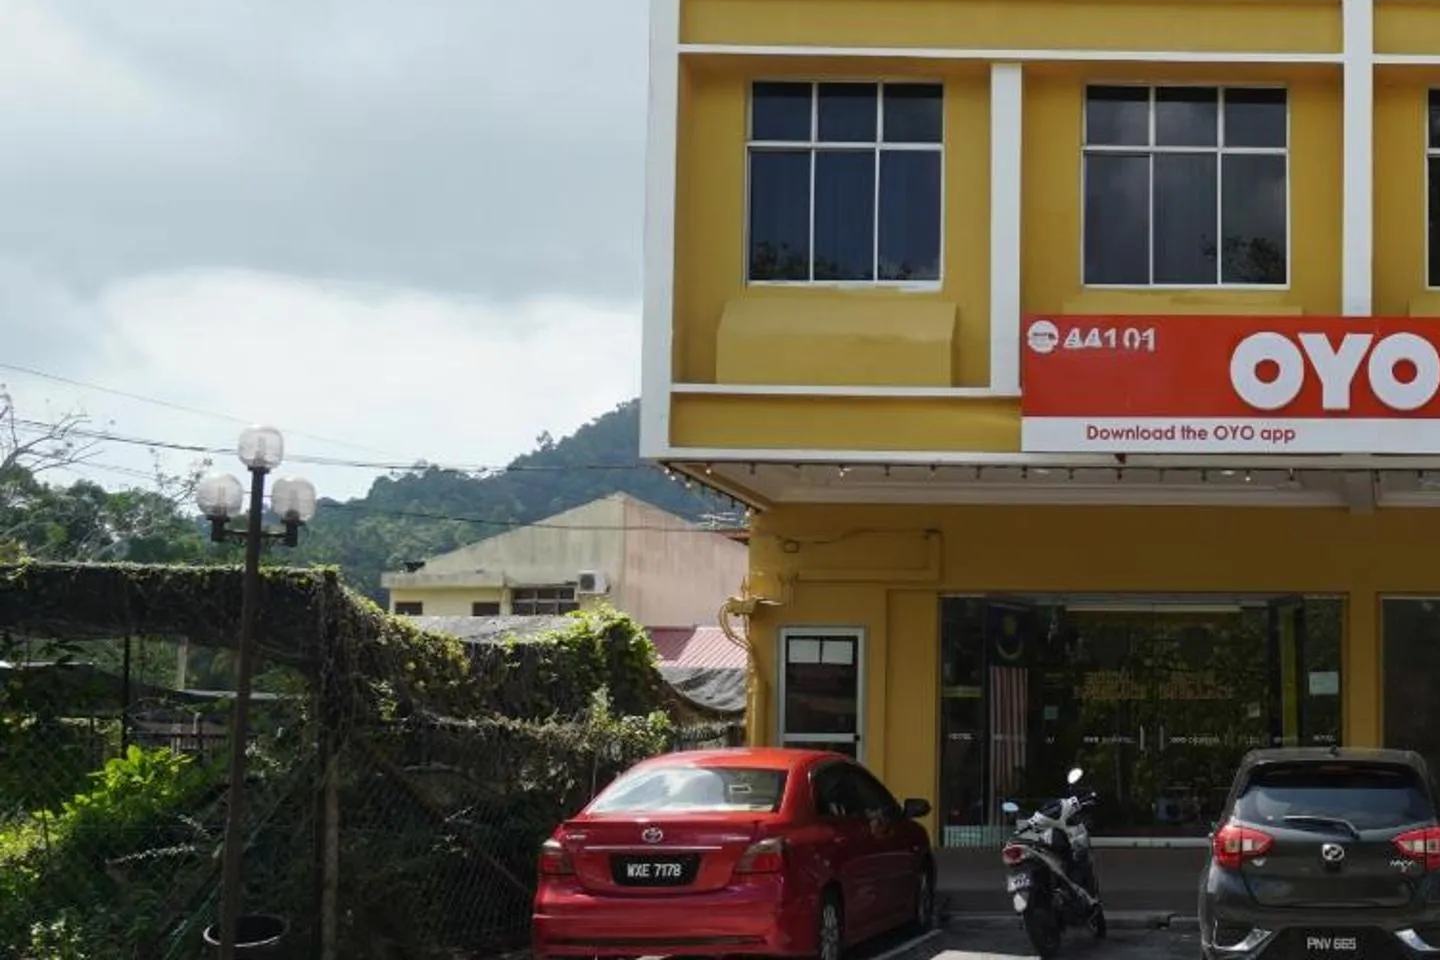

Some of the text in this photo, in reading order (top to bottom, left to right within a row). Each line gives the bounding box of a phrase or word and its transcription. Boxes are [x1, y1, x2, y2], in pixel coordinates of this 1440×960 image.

[1086, 425, 1296, 444] Download the OYO app
[627, 863, 682, 877] WXE 7178
[1307, 937, 1331, 950] PNV
